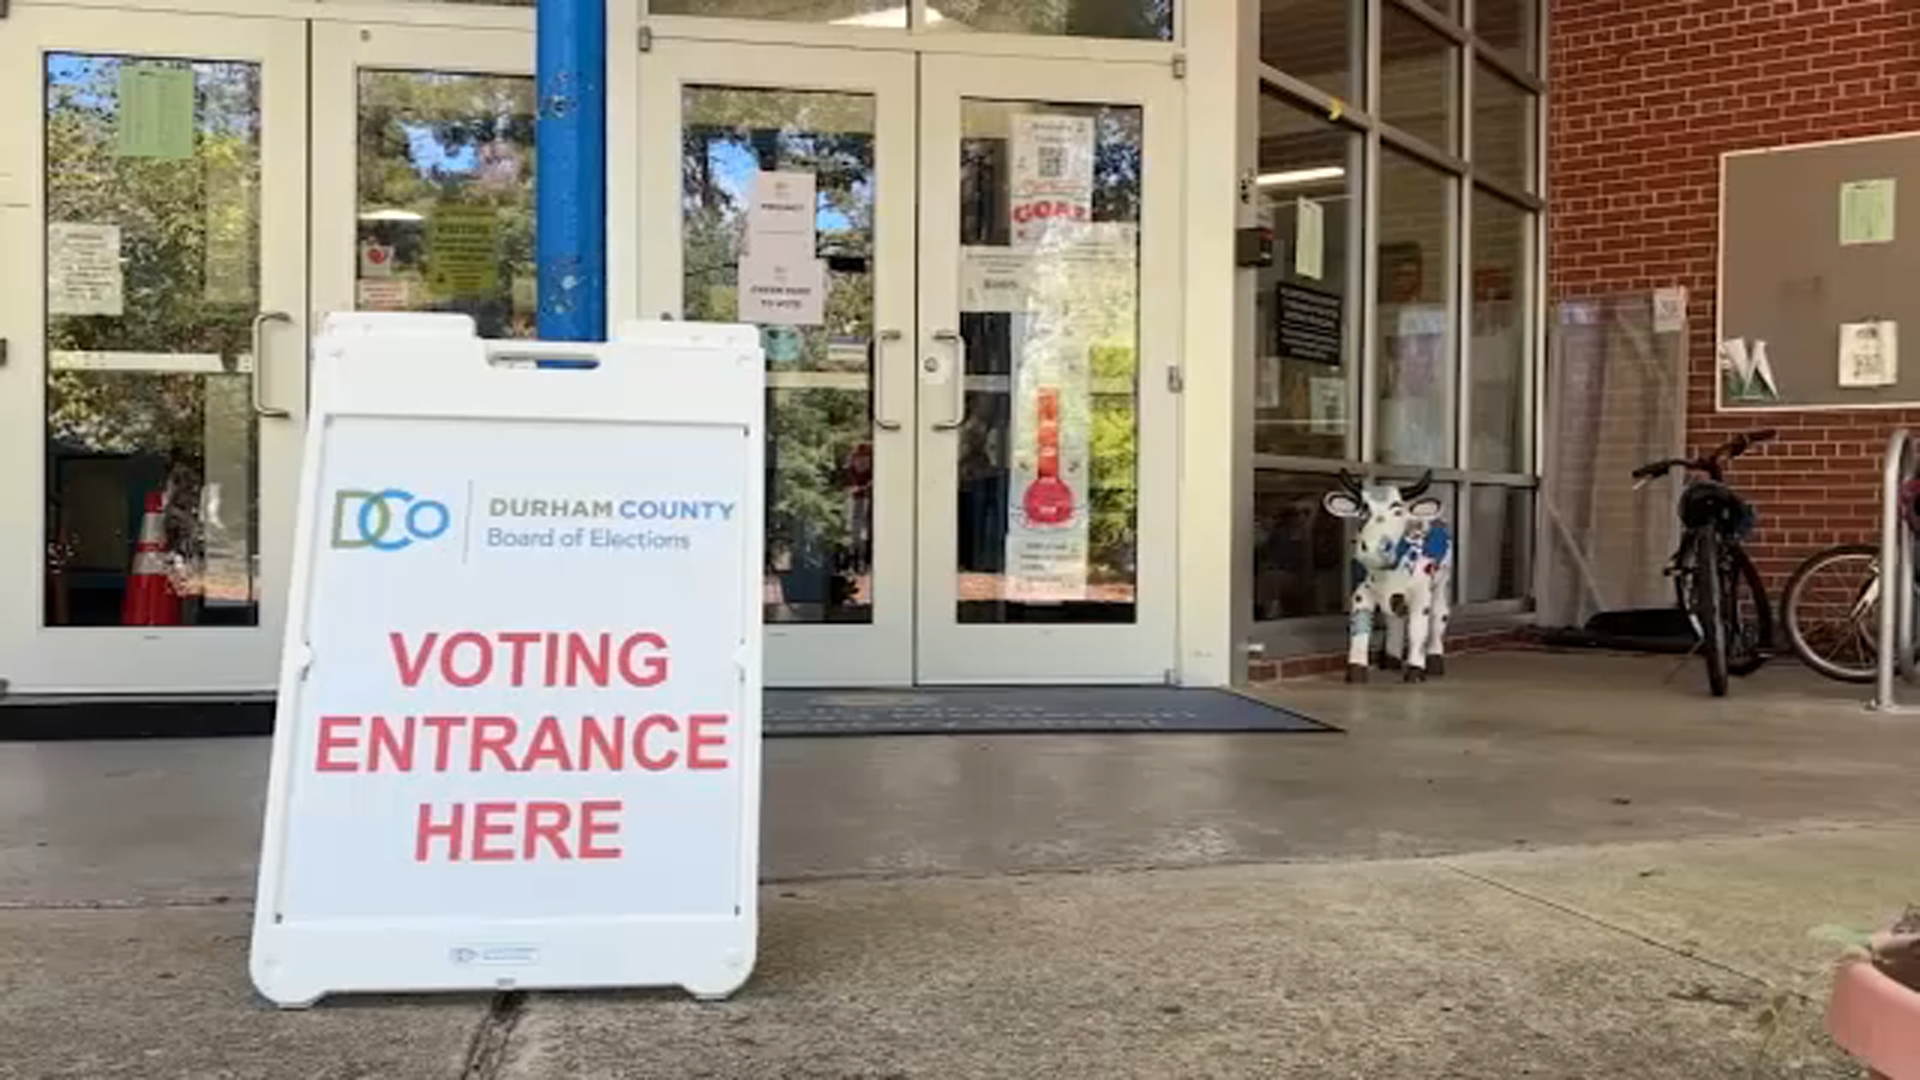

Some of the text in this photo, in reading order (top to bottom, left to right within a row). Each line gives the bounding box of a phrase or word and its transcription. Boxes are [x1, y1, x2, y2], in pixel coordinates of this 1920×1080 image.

[489, 498, 735, 520] DURHAM COUNTY
[487, 528, 691, 550] Board of Elections
[390, 632, 669, 687] VOTING
[315, 714, 729, 773] ENTRANCE
[415, 801, 622, 861] HERE
